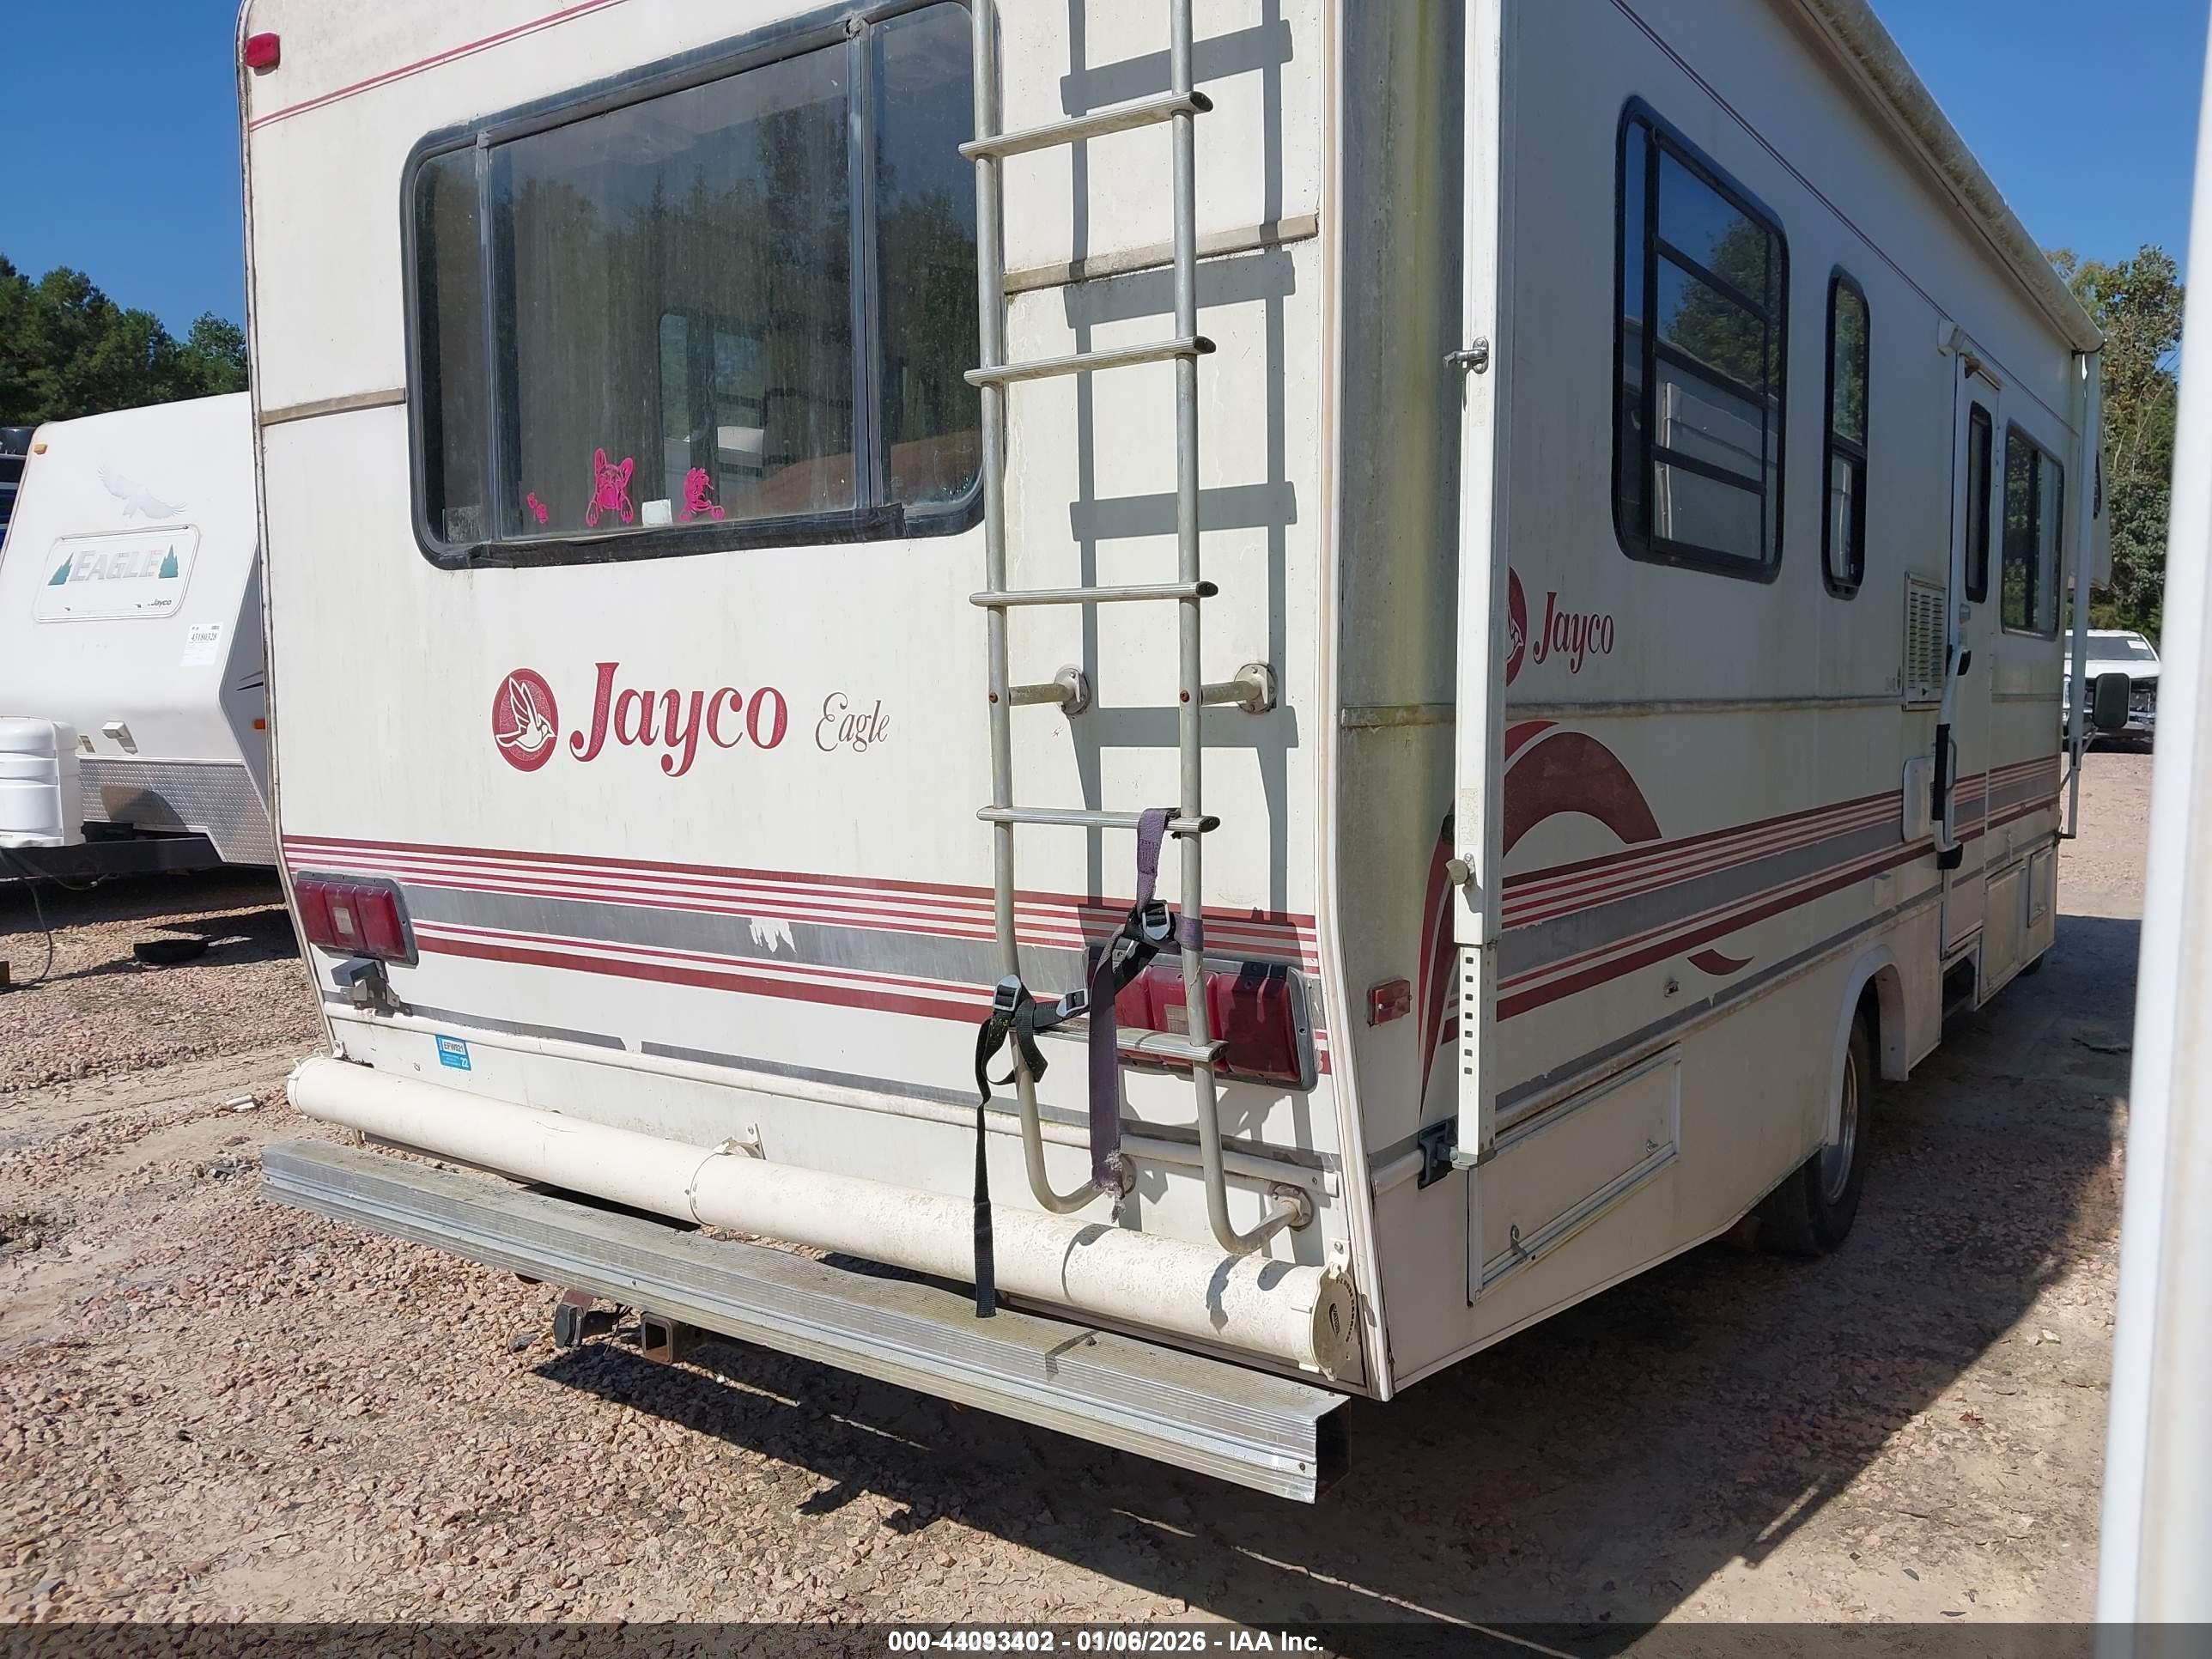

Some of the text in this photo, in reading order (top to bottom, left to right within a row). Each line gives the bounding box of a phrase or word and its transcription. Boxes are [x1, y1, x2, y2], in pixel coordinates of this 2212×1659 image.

[69, 550, 163, 581] EAGLE
[149, 598, 173, 609] Jayco
[1533, 591, 1614, 674] Jayco
[569, 661, 889, 777] Jayco Eagle
